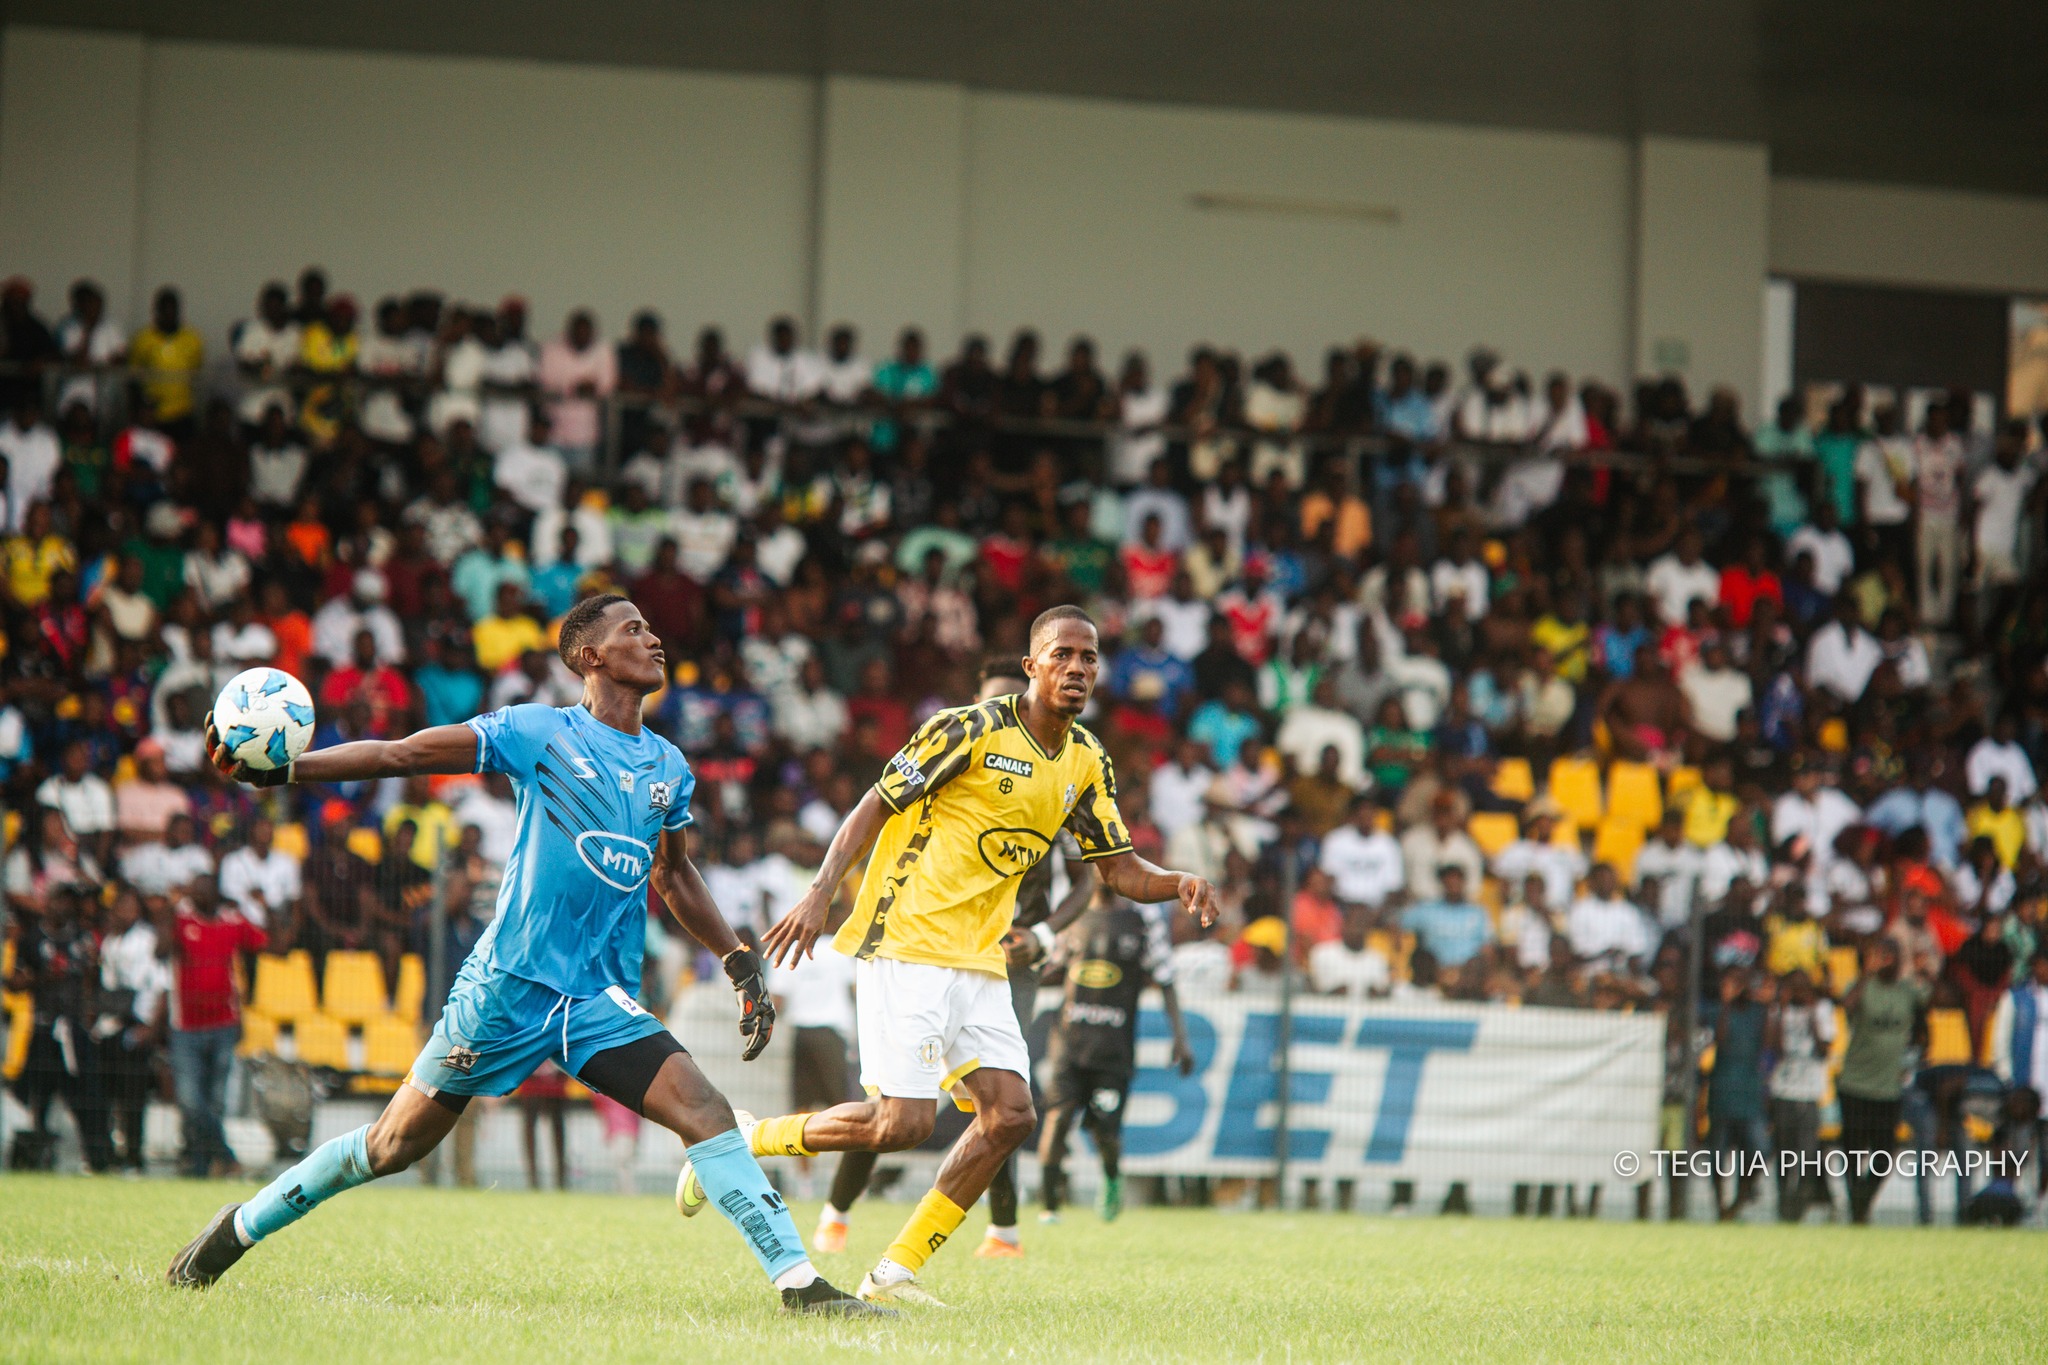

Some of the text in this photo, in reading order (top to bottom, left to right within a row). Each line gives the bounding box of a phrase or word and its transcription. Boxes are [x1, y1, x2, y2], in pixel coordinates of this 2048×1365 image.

[985, 753, 1032, 777] CANAL+
[602, 846, 643, 877] MTN
[998, 841, 1041, 866] MTN
[718, 1189, 756, 1220] UTD
